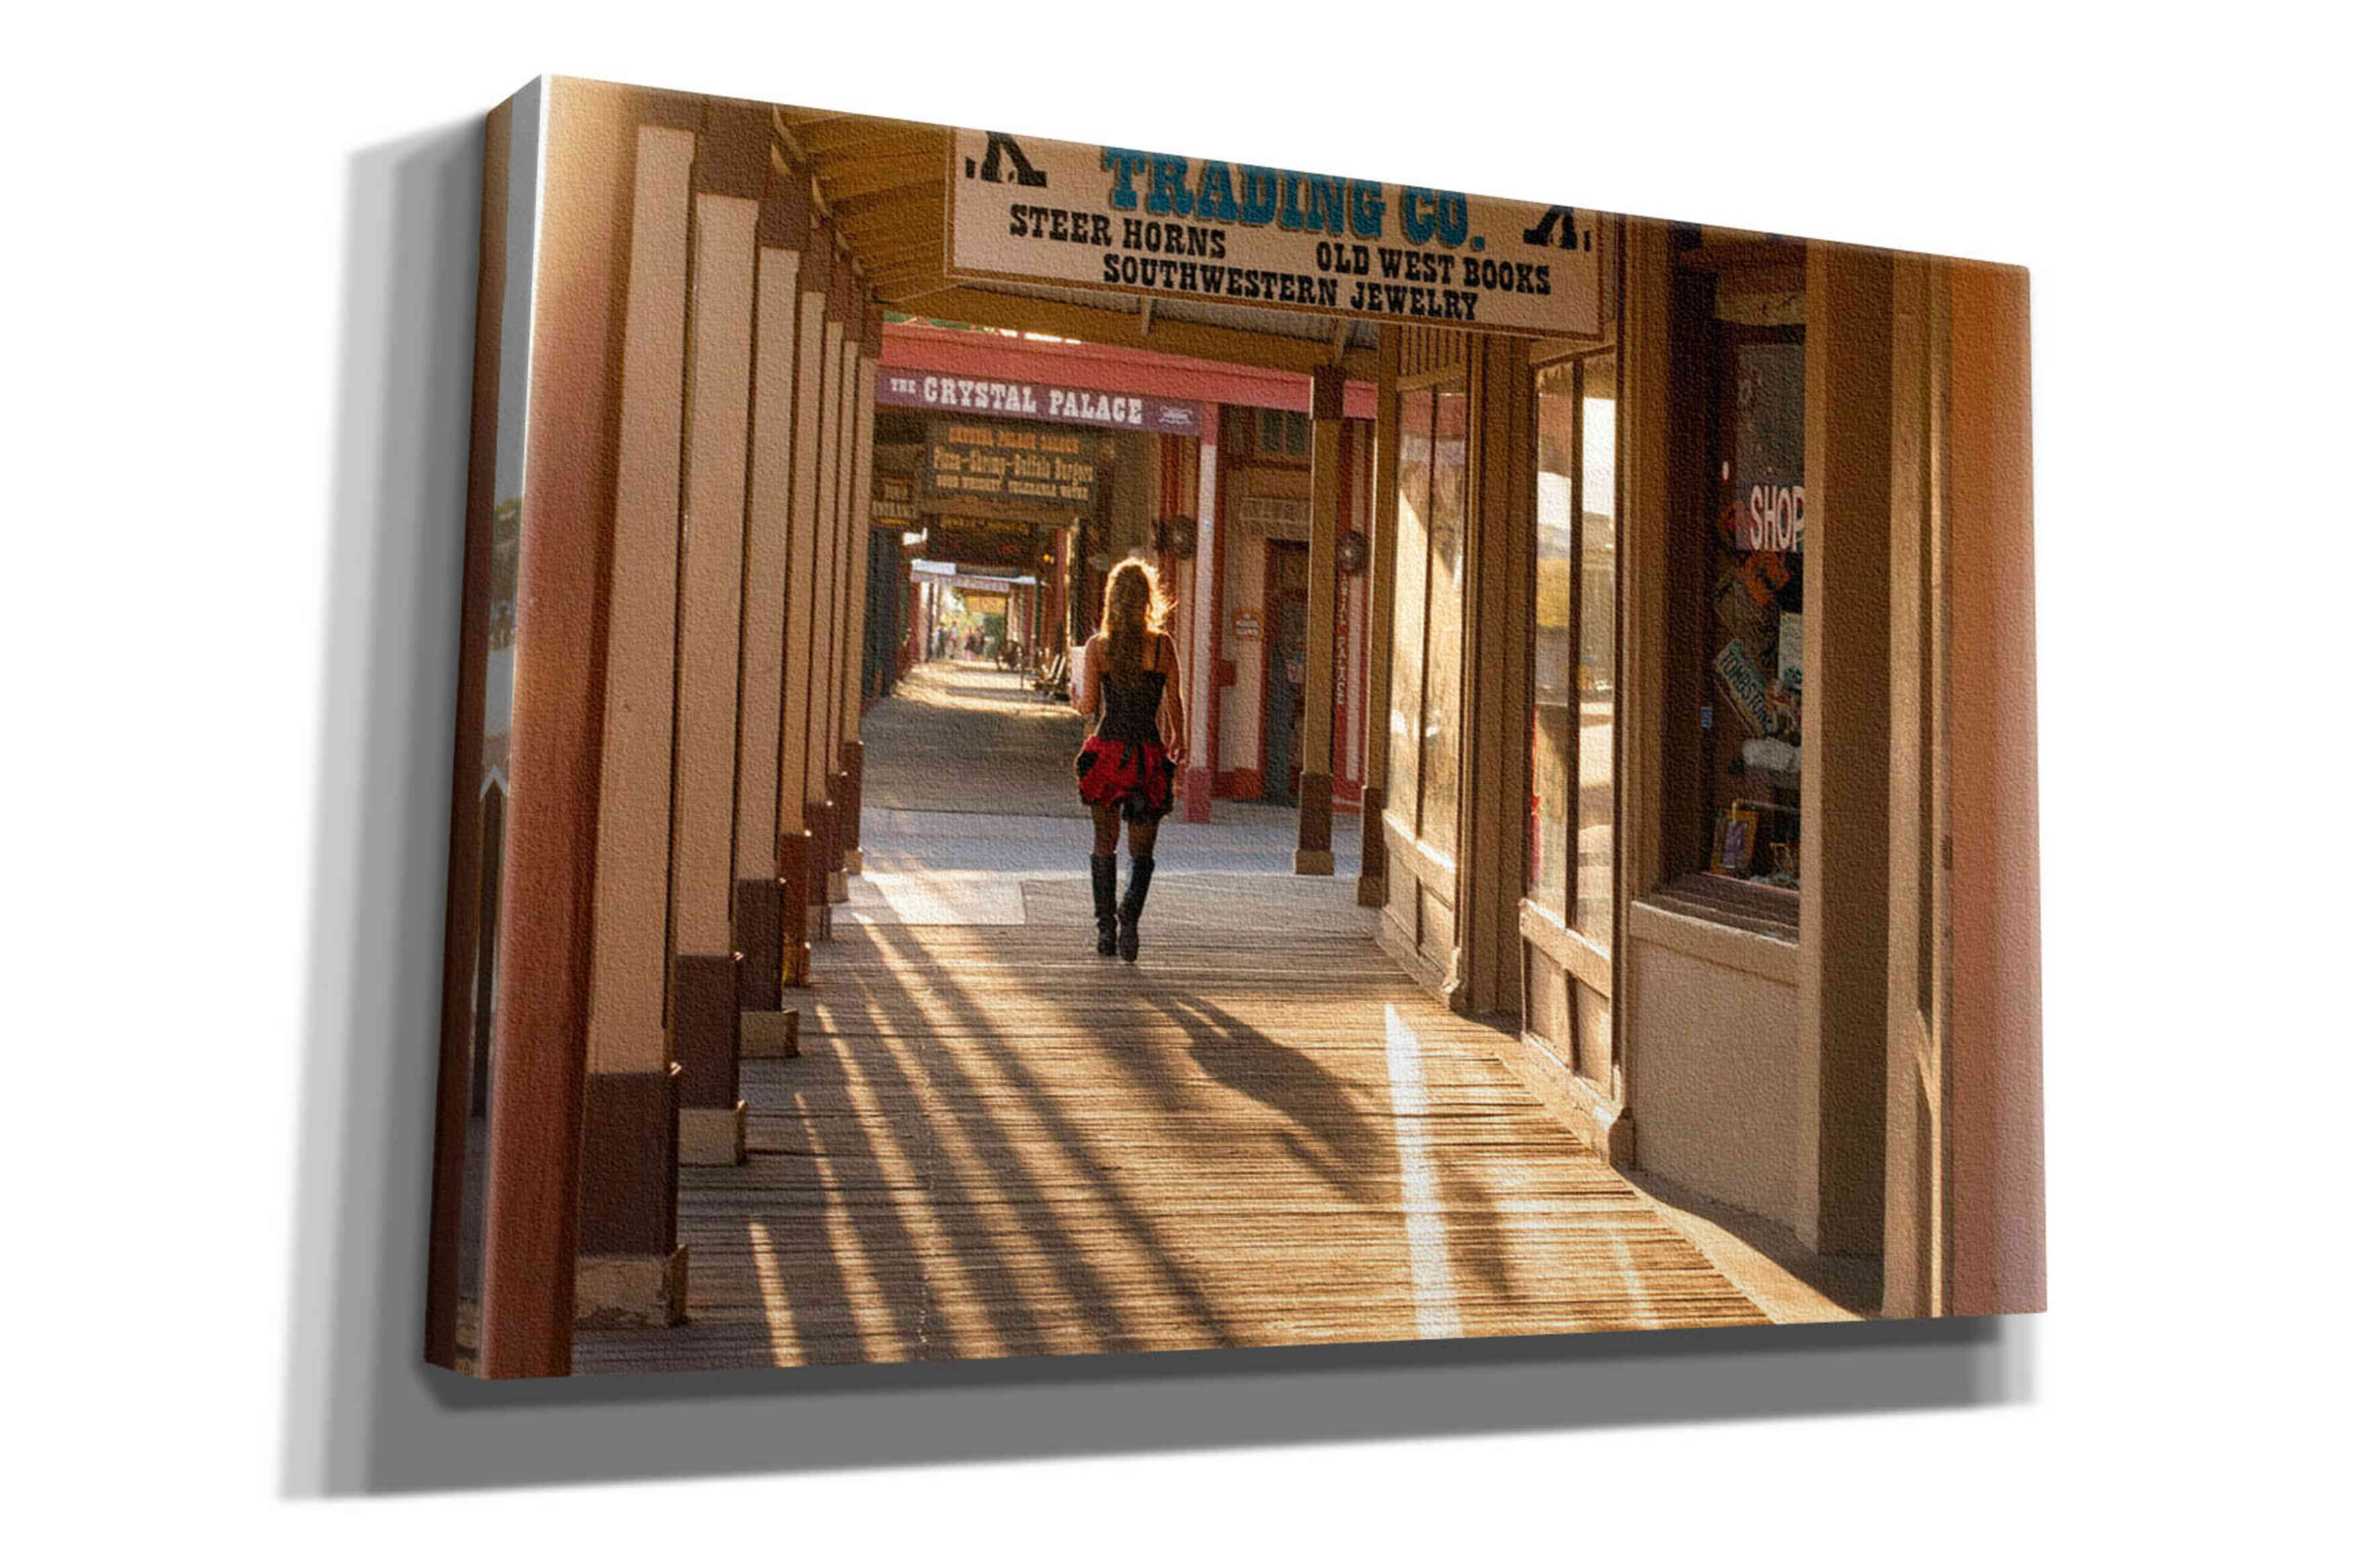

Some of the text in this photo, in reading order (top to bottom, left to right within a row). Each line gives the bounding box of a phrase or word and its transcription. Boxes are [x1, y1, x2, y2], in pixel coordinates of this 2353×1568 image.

[1103, 146, 1485, 249] TRADING CO.
[1010, 203, 1226, 259] STEER HORNS
[1103, 253, 1478, 321] SOUTHWESTERN JEWELRY
[1316, 241, 1551, 296] OLD WEST BOOKS
[890, 378, 916, 394] THE
[923, 376, 1037, 414] CRYSTAL
[1048, 389, 1143, 425] PALACE
[1750, 485, 1804, 552] SHOP
